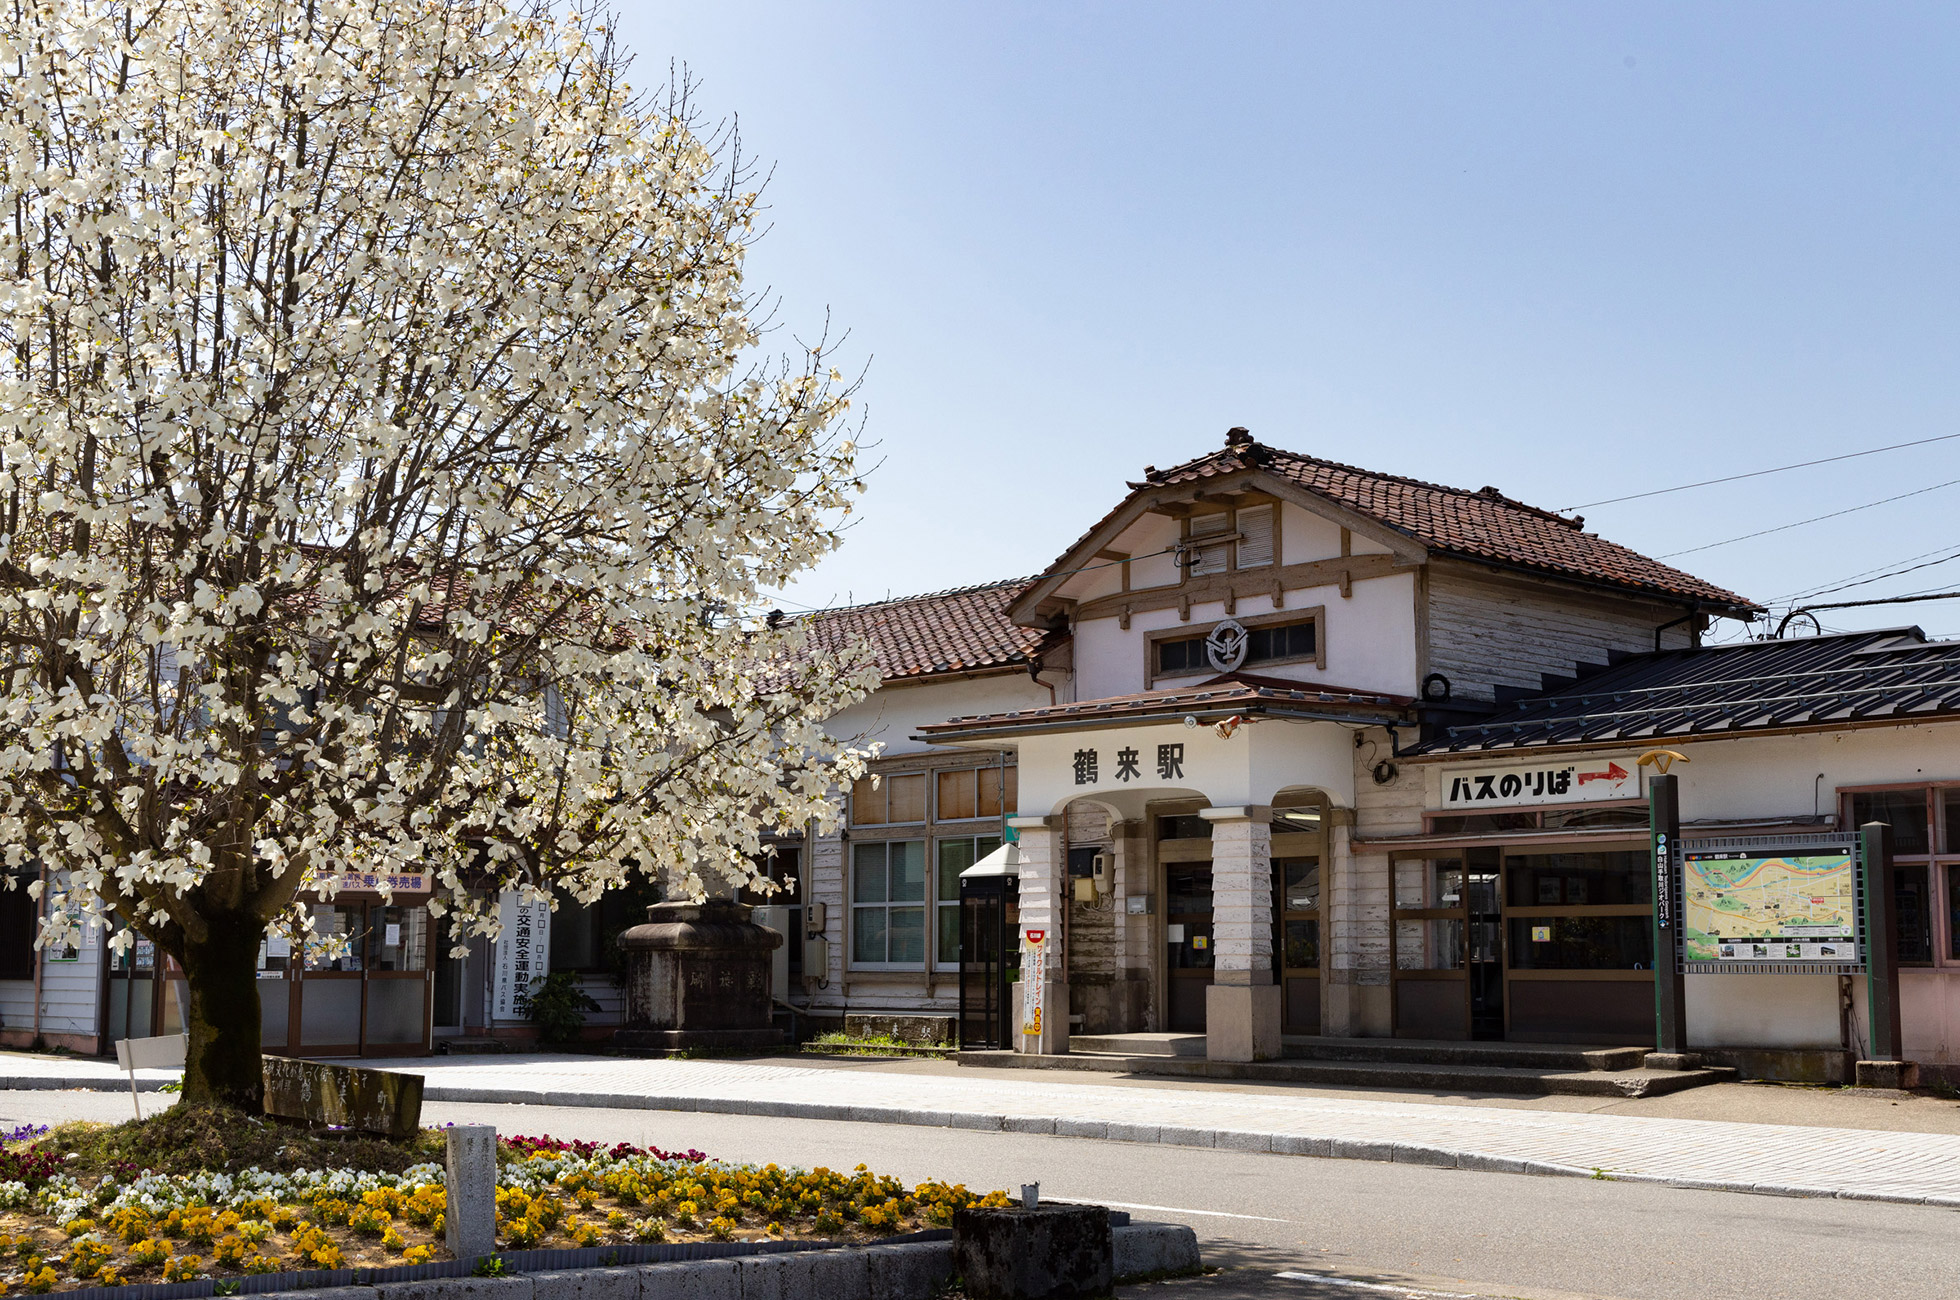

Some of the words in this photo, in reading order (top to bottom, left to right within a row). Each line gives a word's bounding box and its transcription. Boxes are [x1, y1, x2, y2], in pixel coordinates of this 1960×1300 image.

[1072, 743, 1184, 785] 鶴来駅
[1450, 766, 1575, 802] バスのりば
[363, 874, 422, 889] 乗券売場
[1657, 856, 1665, 919] 白山手取川ジオパーク
[1035, 944, 1043, 1005] サイクルトレイン
